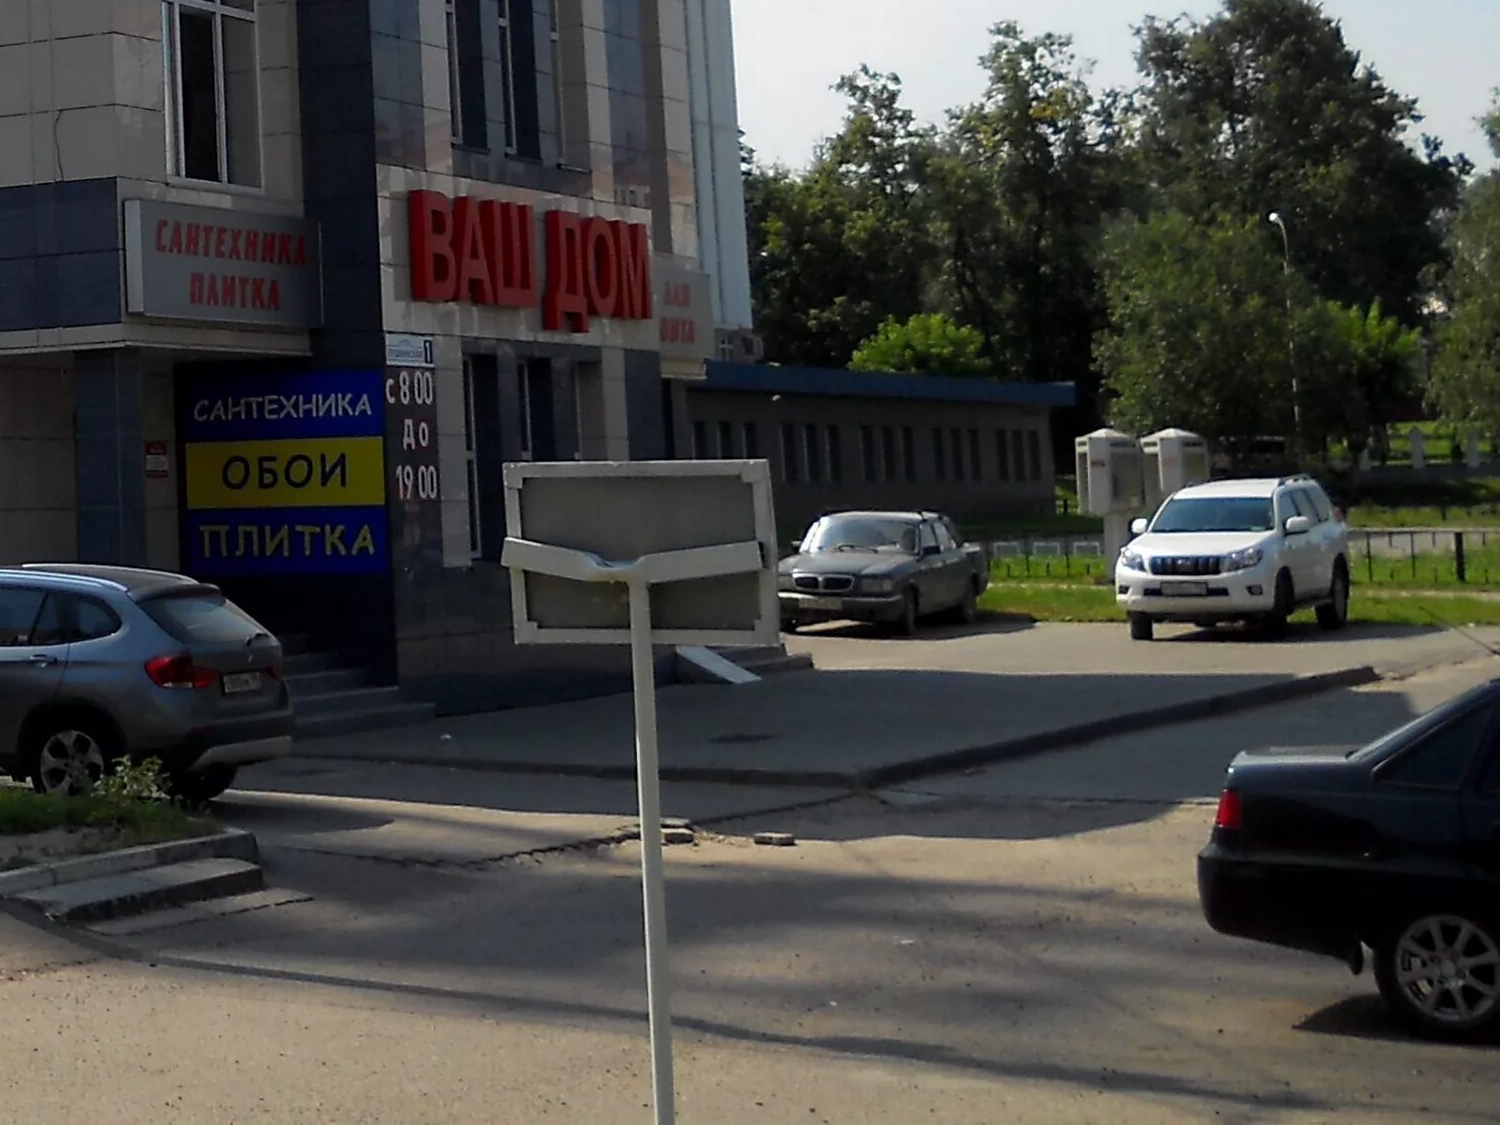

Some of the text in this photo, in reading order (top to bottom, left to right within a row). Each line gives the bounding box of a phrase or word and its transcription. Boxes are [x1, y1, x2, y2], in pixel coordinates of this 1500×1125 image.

[156, 219, 307, 267] САНТЕХНИКА
[408, 189, 652, 332] ВАШ ДОМ
[190, 272, 280, 310] ПЛИТКА
[399, 371, 410, 405] 8
[414, 371, 433, 405] 00
[194, 392, 373, 422] САНТЕХНИКА
[222, 452, 347, 490] ОБОИ
[396, 465, 438, 500] 19 00
[199, 523, 375, 558] ПЛИТКА
